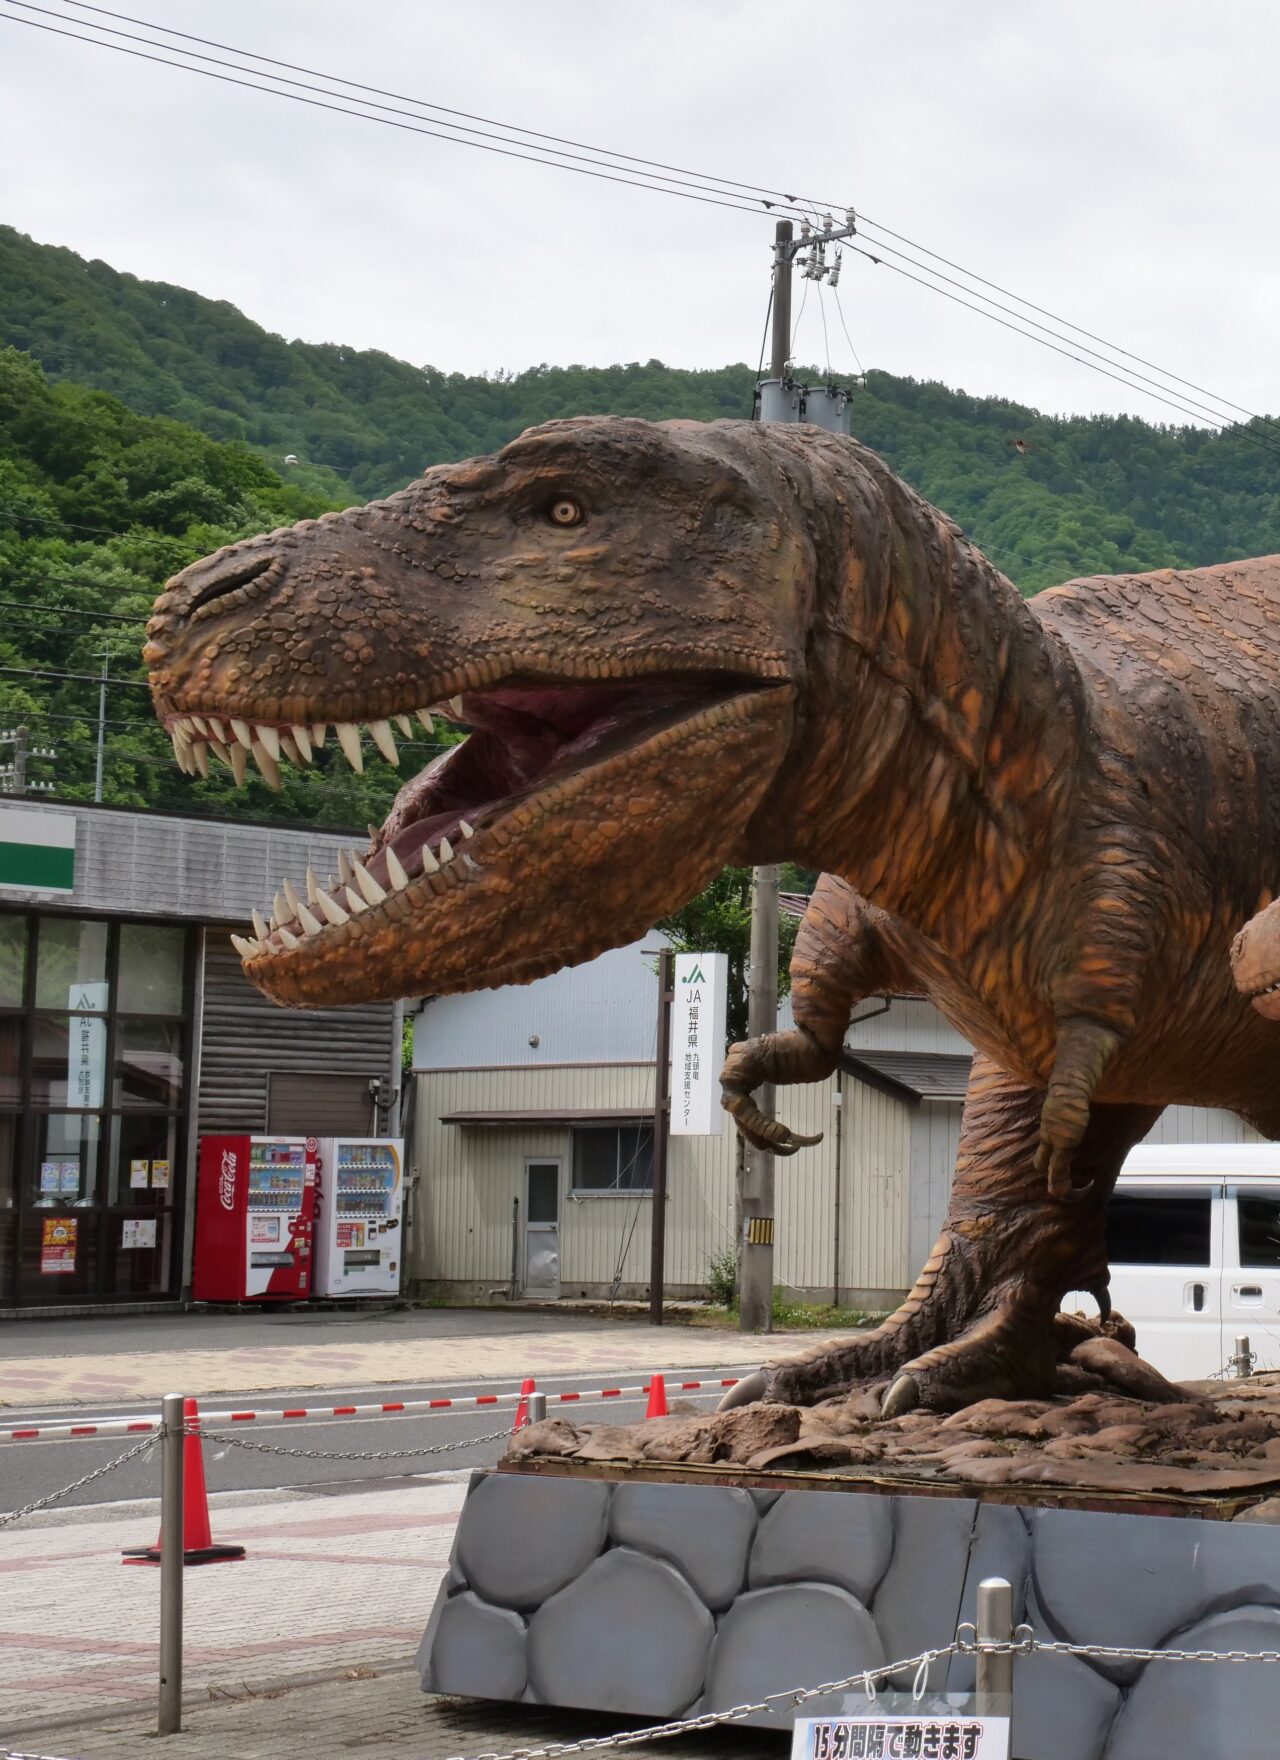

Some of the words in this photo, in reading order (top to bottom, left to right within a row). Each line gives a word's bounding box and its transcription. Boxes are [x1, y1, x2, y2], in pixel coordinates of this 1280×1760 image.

[686, 989, 702, 1004] JA
[687, 1006, 698, 1048] 福井県
[692, 1052, 700, 1081] 九頭竜
[683, 1052, 693, 1127] 地域支援センター
[220, 1149, 237, 1211] Coca-Cola
[814, 1723, 982, 1760] 15分間隔で動きます
